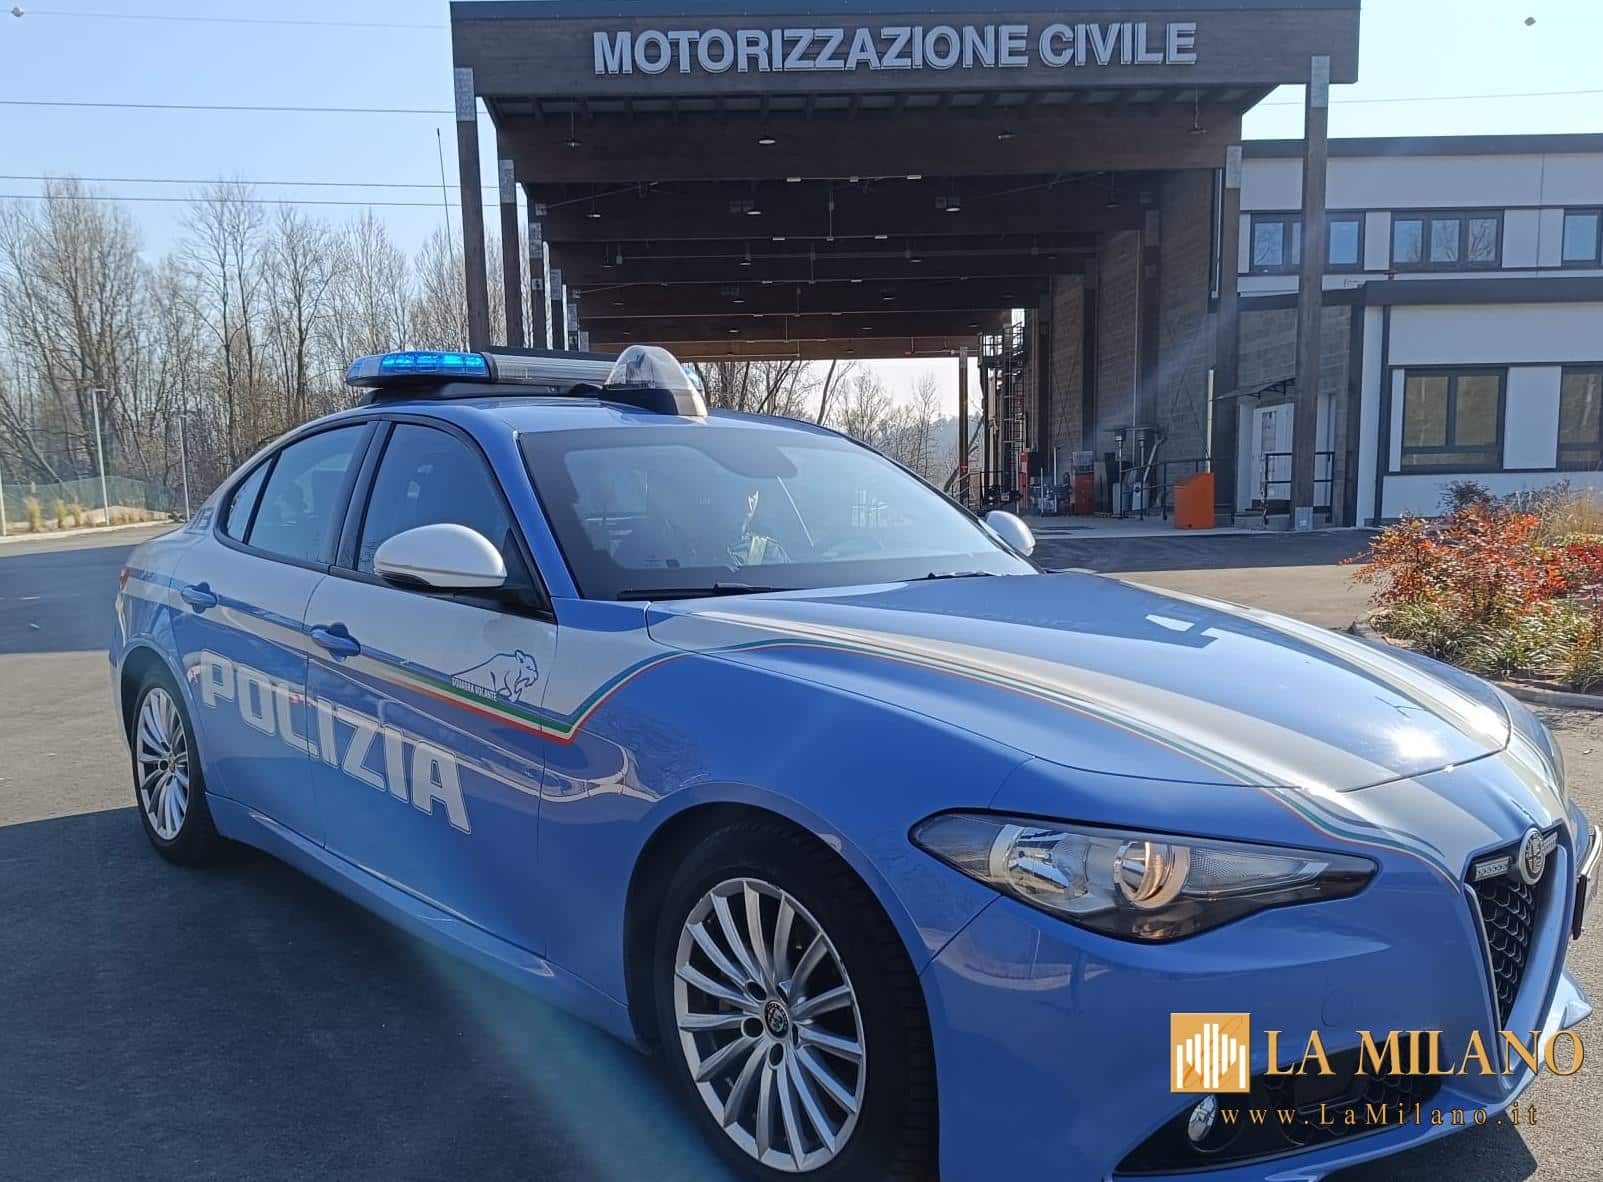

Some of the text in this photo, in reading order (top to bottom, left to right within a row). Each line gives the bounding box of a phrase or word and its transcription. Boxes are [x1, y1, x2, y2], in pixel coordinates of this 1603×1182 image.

[592, 22, 1198, 74] MOTORIZZAZIONE CIVILE
[200, 648, 472, 834] POLIZIA
